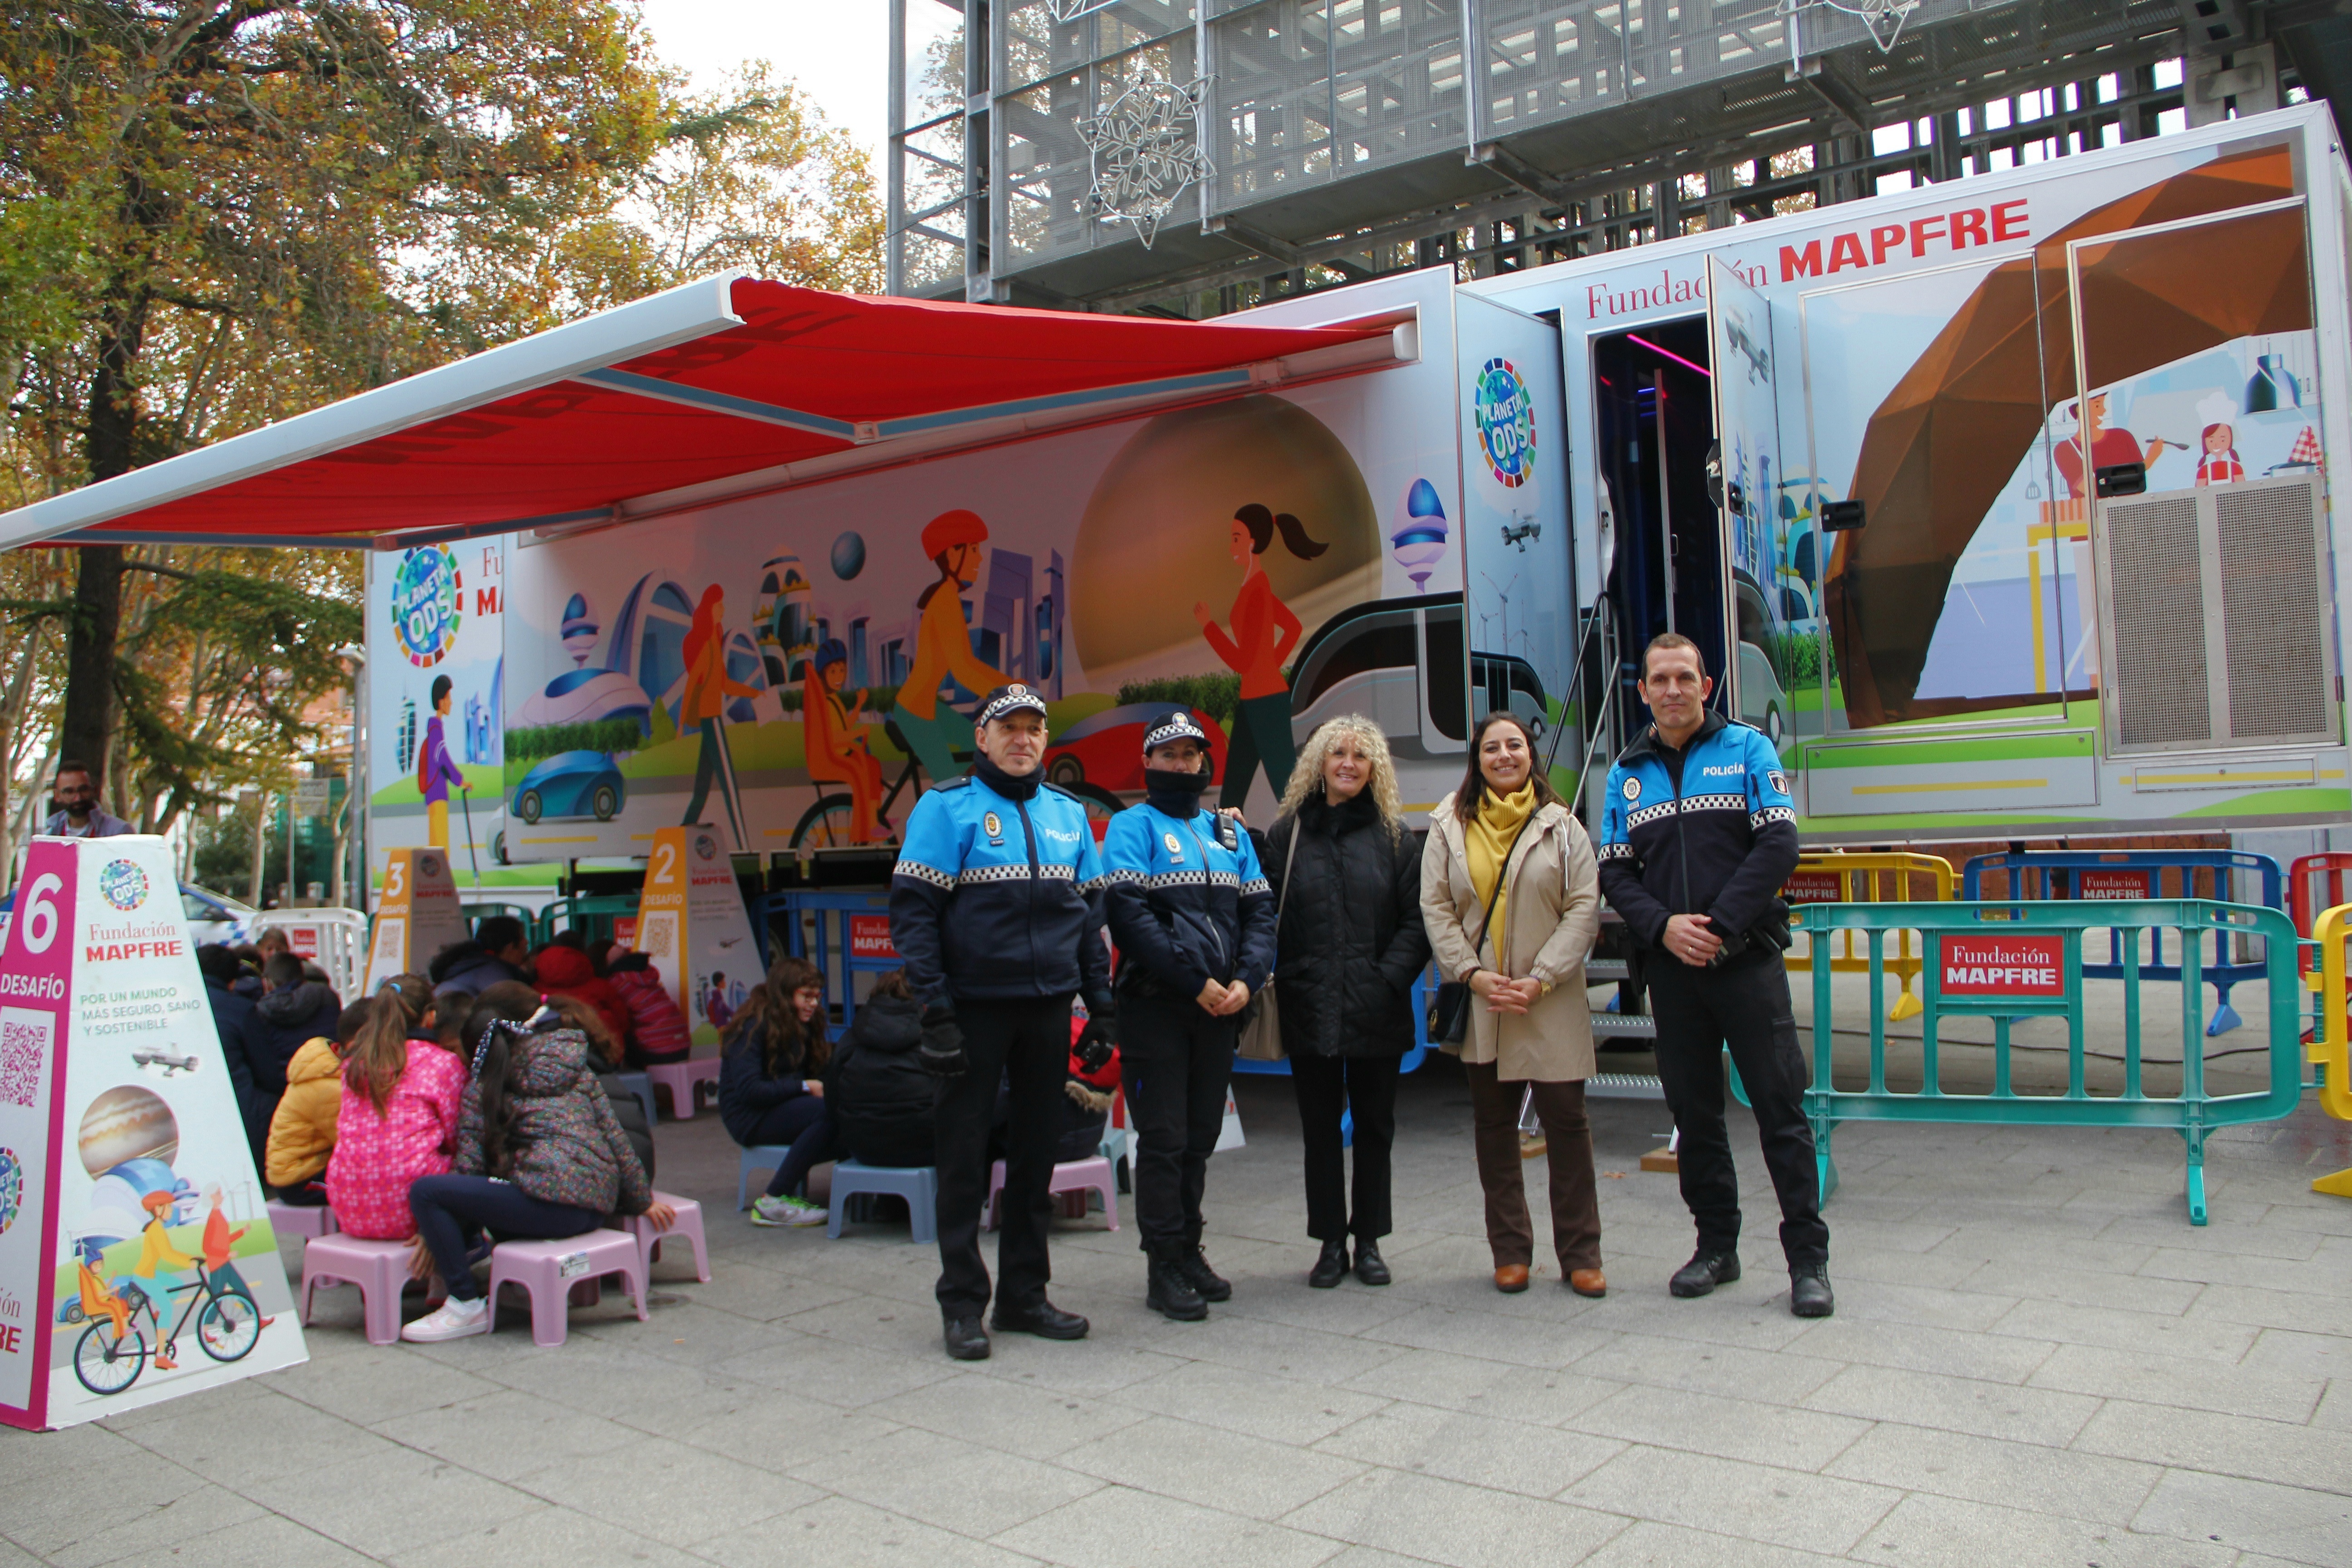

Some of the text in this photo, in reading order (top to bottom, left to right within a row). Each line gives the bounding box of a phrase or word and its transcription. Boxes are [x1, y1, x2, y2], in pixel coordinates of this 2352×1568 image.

[1779, 198, 2030, 283] MAPFRE
[1482, 392, 1524, 421] PLANETA
[1492, 417, 1528, 460] ODS
[399, 562, 448, 613] PLANETA
[408, 589, 453, 643] ODS
[1703, 762, 1744, 776] POLICÍA
[654, 843, 676, 883] 2
[106, 870, 137, 888] PLANETA
[387, 862, 405, 897] 3
[1788, 877, 1834, 887] Fundación
[2087, 876, 2141, 888] Fundación
[113, 880, 142, 901] ODS
[645, 892, 683, 905] DESAFÍO
[2083, 889, 2144, 899] MAPFRE
[22, 872, 63, 954] 6
[380, 902, 408, 915] DESAFÍO
[89, 921, 176, 941] Fundación
[87, 940, 182, 961] MAPFRE
[1953, 946, 2049, 964] Fundación
[0, 972, 65, 1000] DESAFÍO
[1947, 967, 2056, 985] MAPFRE
[81, 987, 177, 1004] POR UN MUNDO
[82, 999, 201, 1020] MÁS SEGURO, SANO
[83, 1018, 168, 1036] Y SOSTENIBLE
